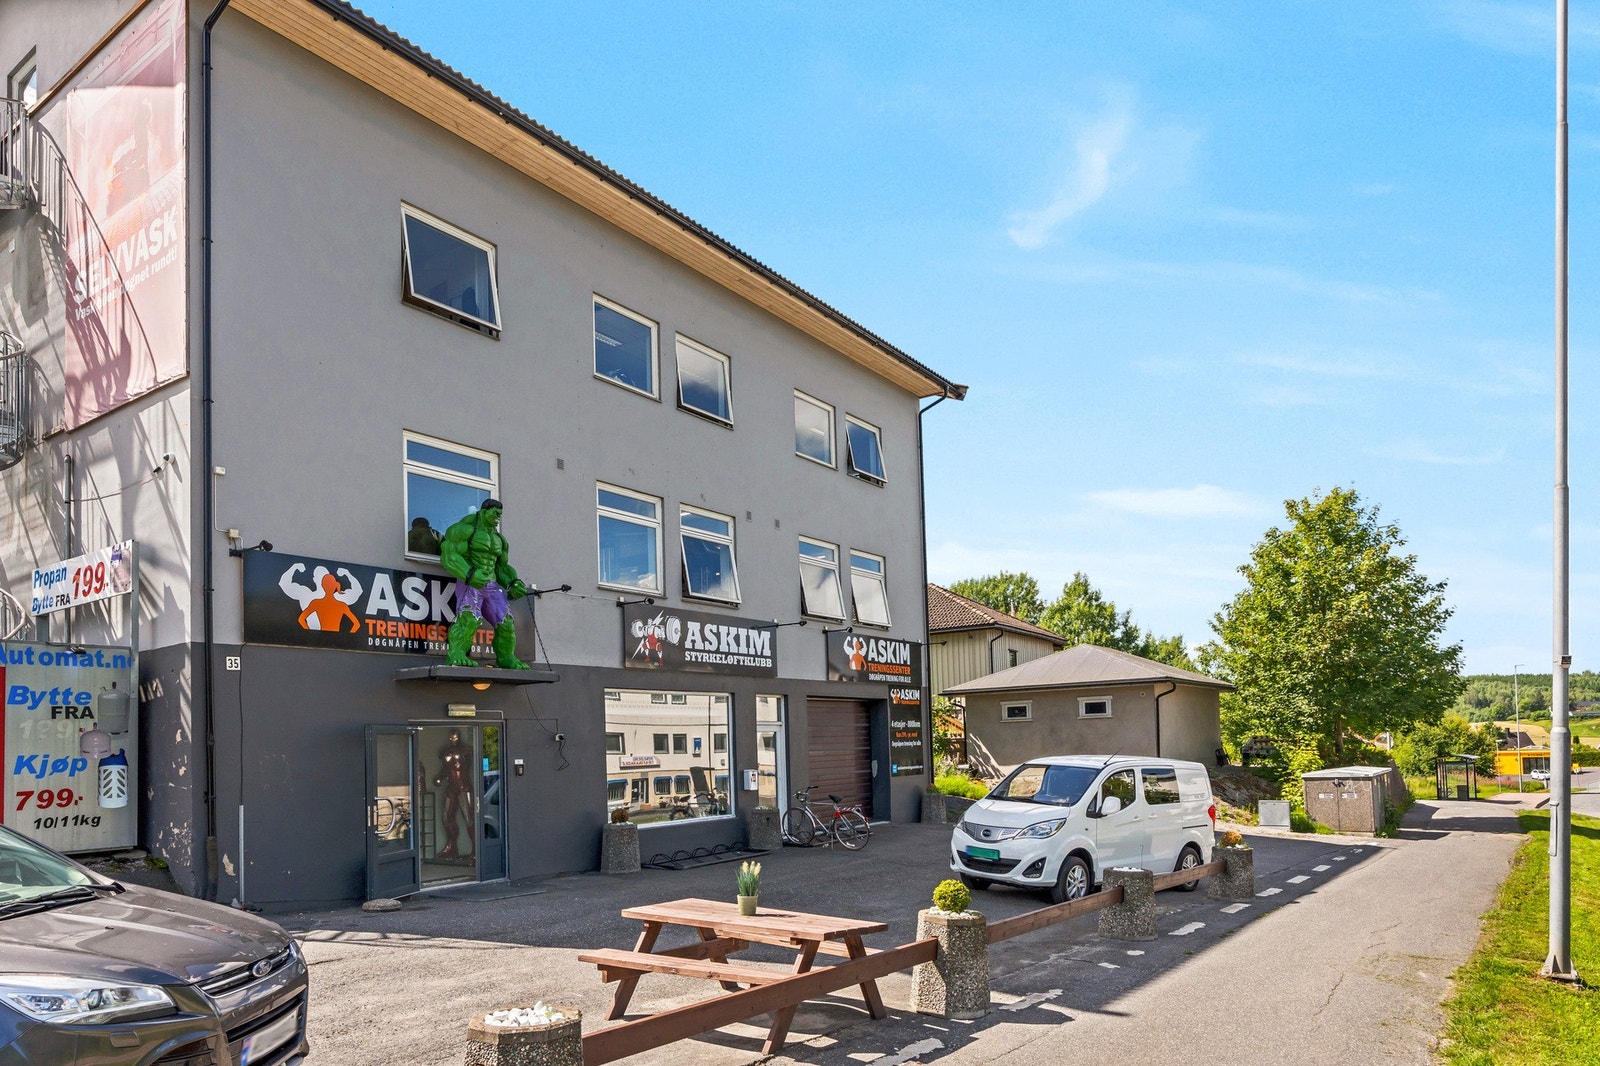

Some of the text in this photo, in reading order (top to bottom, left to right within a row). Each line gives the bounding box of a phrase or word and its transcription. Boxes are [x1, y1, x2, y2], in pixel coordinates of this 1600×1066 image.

[33, 566, 67, 590] Propan
[32, 593, 71, 614] Bytte FRA
[365, 572, 458, 623] ASK
[365, 618, 495, 645] TRENINGSTE
[684, 621, 771, 657] ASKIM
[368, 637, 419, 649] DØGNÅPEN
[423, 643, 450, 651] TRENI
[471, 645, 482, 654] OR
[867, 638, 911, 665] ASKIM
[227, 658, 239, 669] 35
[684, 650, 773, 668] STYRKELØFTKLUBB
[867, 663, 911, 675] TRENINGSSENTER
[7, 685, 92, 711] Bytte
[900, 688, 920, 700] ASKIM
[51, 706, 95, 720] FRA
[13, 754, 88, 779] Kjøp
